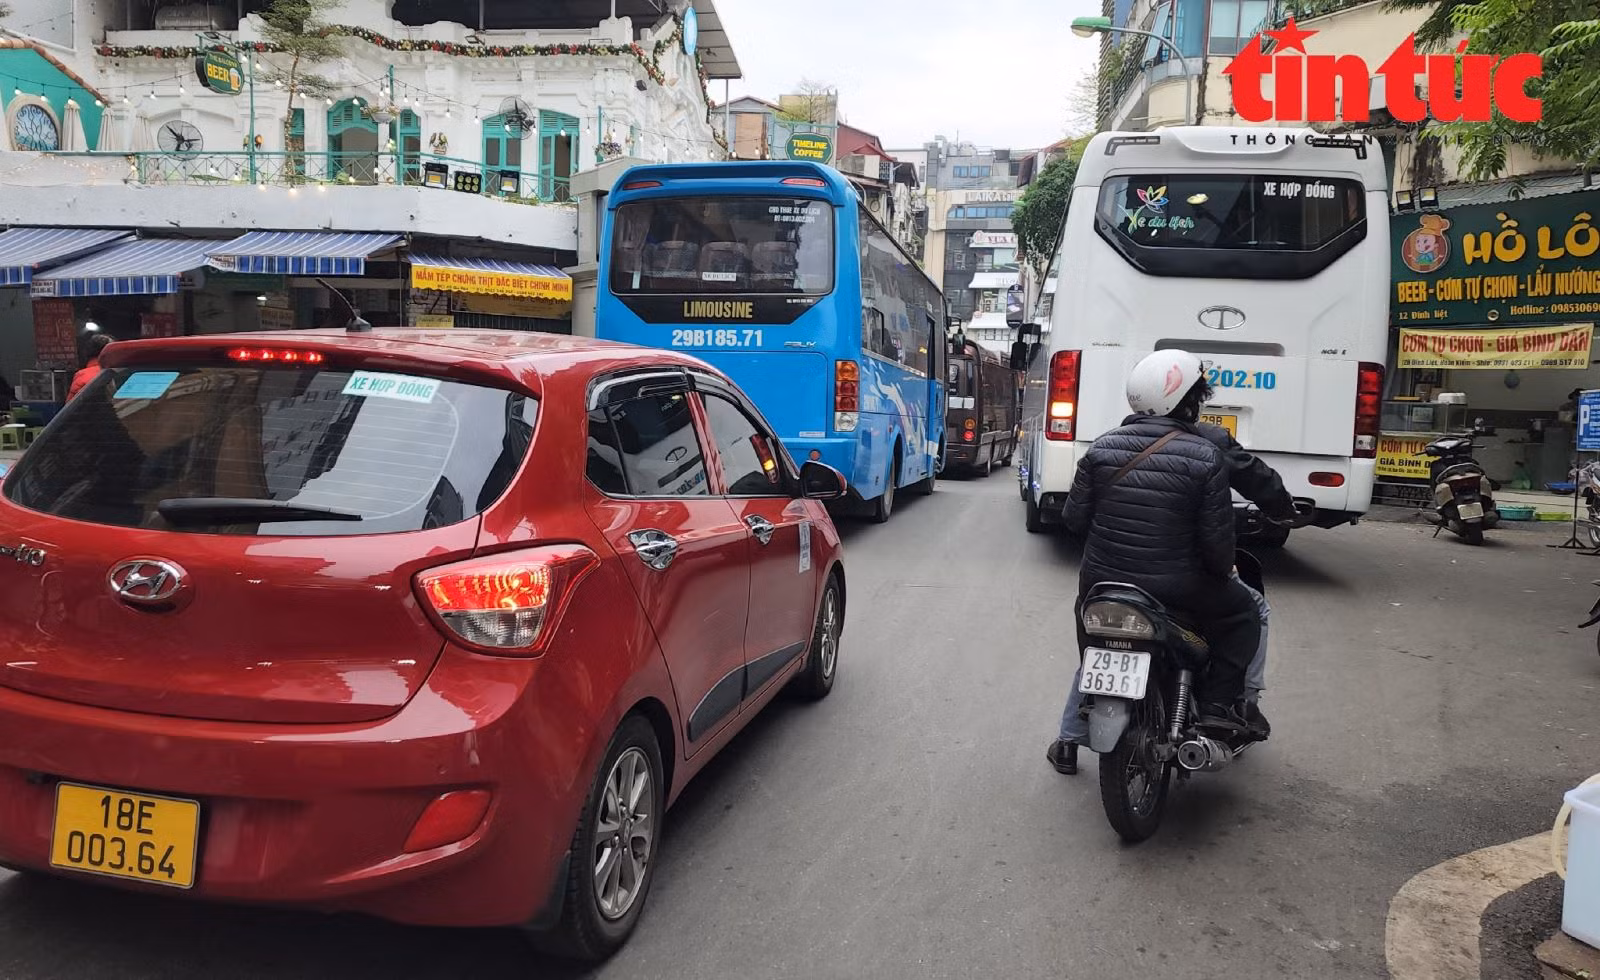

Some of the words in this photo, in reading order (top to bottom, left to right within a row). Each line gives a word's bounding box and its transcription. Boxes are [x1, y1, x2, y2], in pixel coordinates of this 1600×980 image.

[207, 63, 229, 83] BEER
[792, 140, 828, 149] TIMELINE
[794, 149, 824, 158] COFFEE
[1264, 182, 1276, 195] XE
[1280, 182, 1301, 199] HỢP
[1462, 211, 1526, 265] HỒ
[1537, 211, 1600, 260] LÔ
[1397, 281, 1428, 303] BEER
[1436, 276, 1462, 301] CƠM
[683, 301, 753, 318] LIMOUSINE
[1399, 312, 1408, 320] 12
[671, 329, 763, 347] 29B185.71
[350, 376, 369, 390] XE
[1381, 440, 1402, 453] CƠM
[1380, 457, 1395, 465] GIÁ
[1398, 458, 1421, 467] BÌNH
[1105, 640, 1132, 649] YAMAHA
[1092, 651, 1139, 673] 29-B1
[1084, 671, 1141, 695] 363.61
[101, 794, 156, 835] 18E
[67, 830, 175, 879] 003.64
